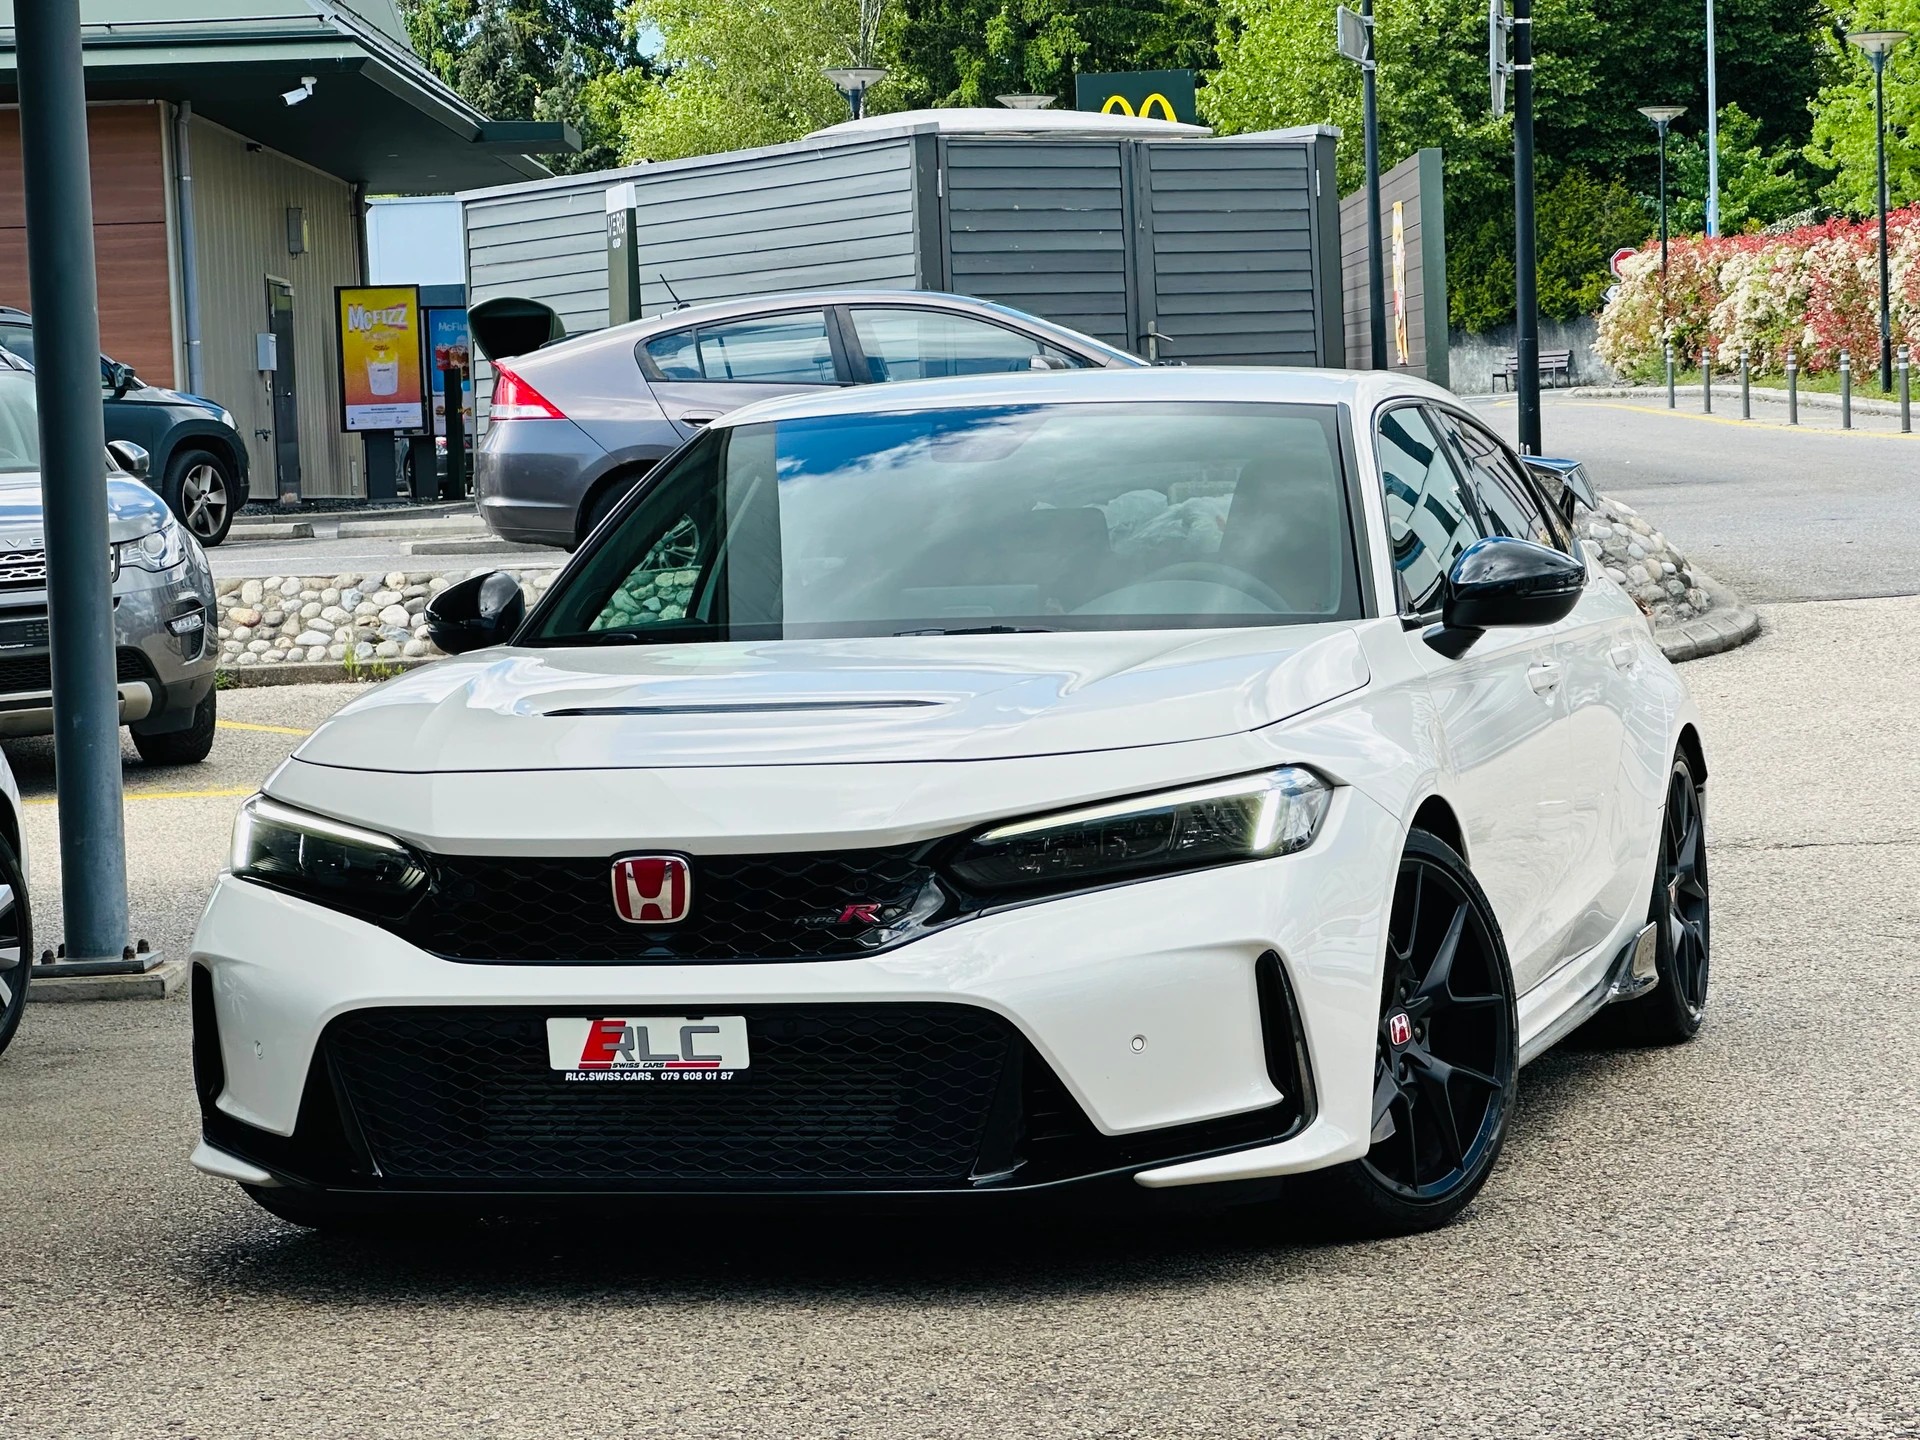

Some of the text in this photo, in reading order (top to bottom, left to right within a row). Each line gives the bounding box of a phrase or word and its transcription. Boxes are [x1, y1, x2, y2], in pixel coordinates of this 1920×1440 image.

[837, 903, 882, 924] R
[565, 1071, 734, 1081] RLC.SWISS.CARS. 079 608 01 87
